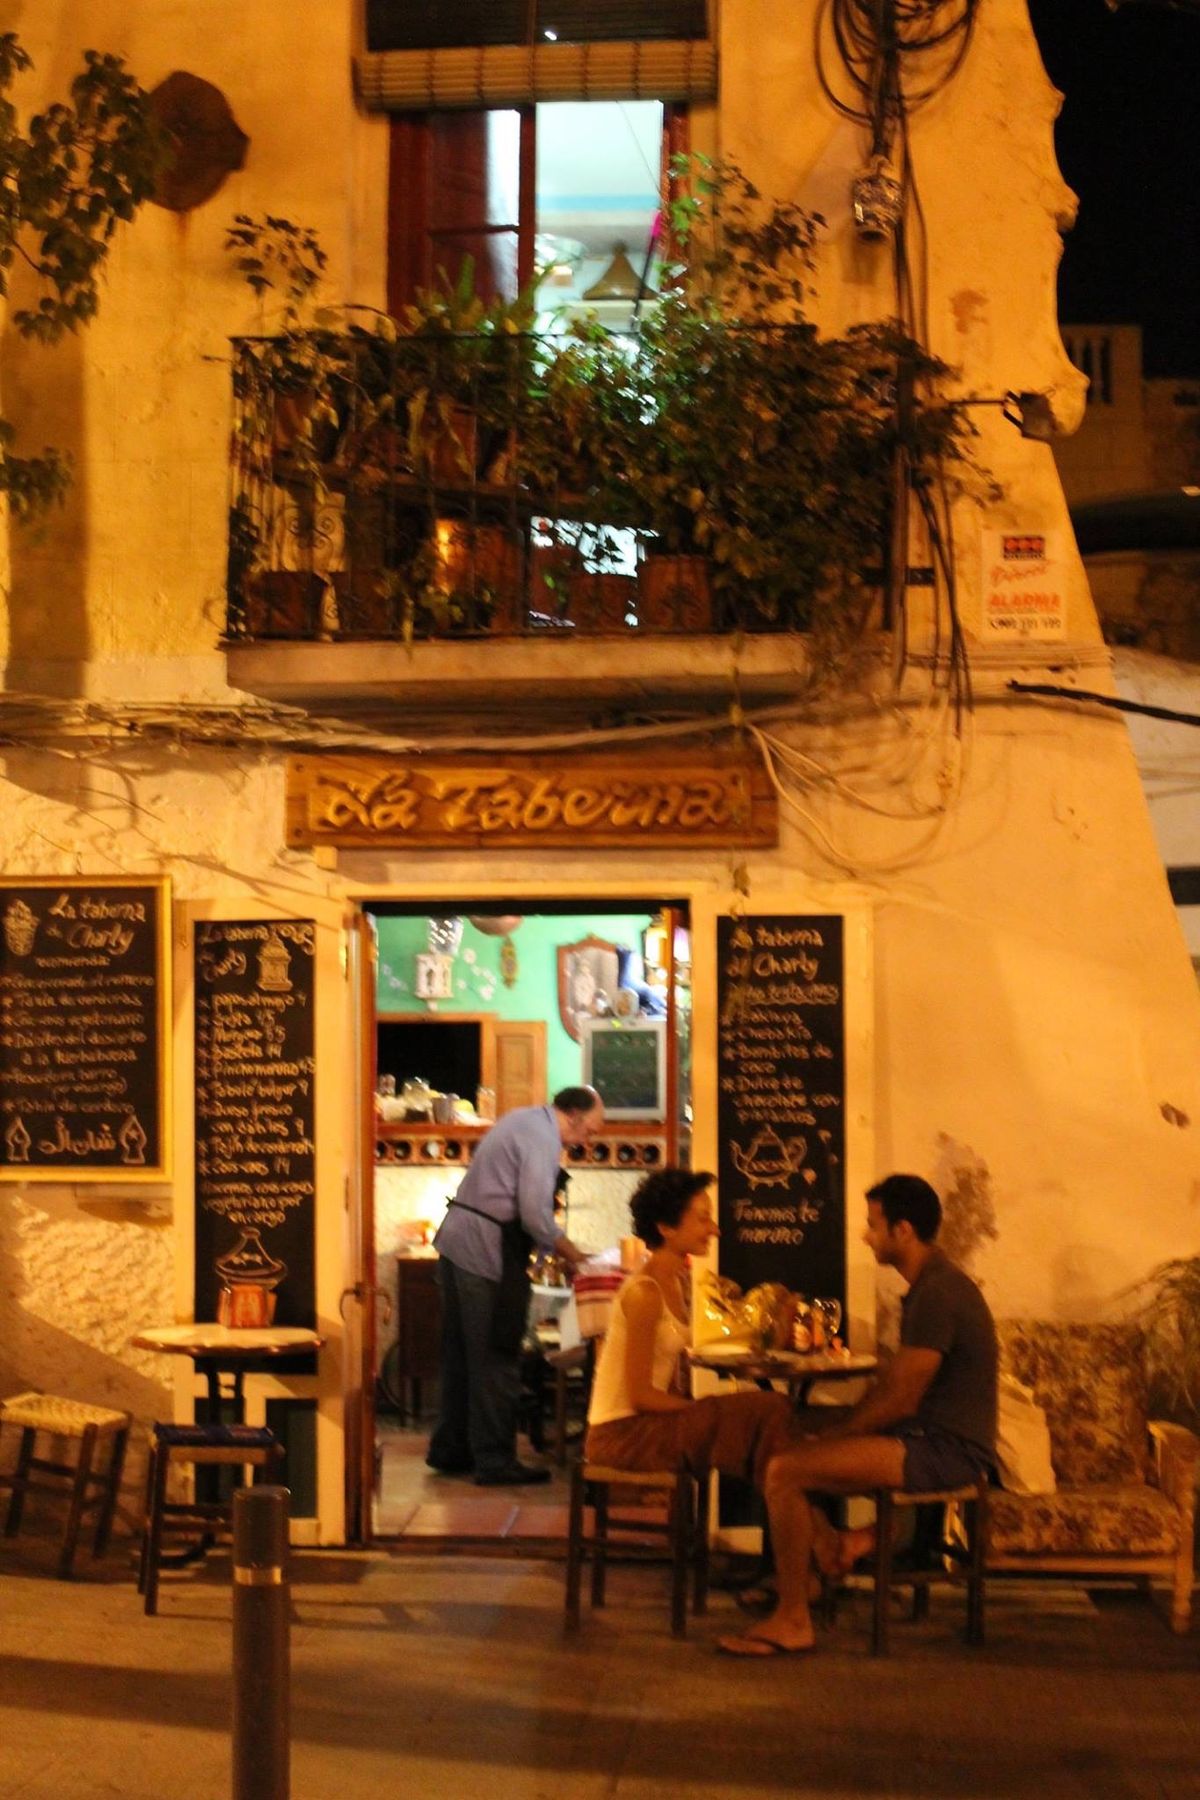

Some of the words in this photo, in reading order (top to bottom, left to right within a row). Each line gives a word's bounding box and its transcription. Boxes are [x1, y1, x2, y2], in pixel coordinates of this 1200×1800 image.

[318, 769, 415, 830] La
[432, 771, 733, 832] Taberna
[49, 893, 77, 919] La
[79, 896, 147, 922] taberna
[67, 922, 136, 955] Charly
[755, 924, 825, 947] taberna
[752, 949, 820, 981] Charly
